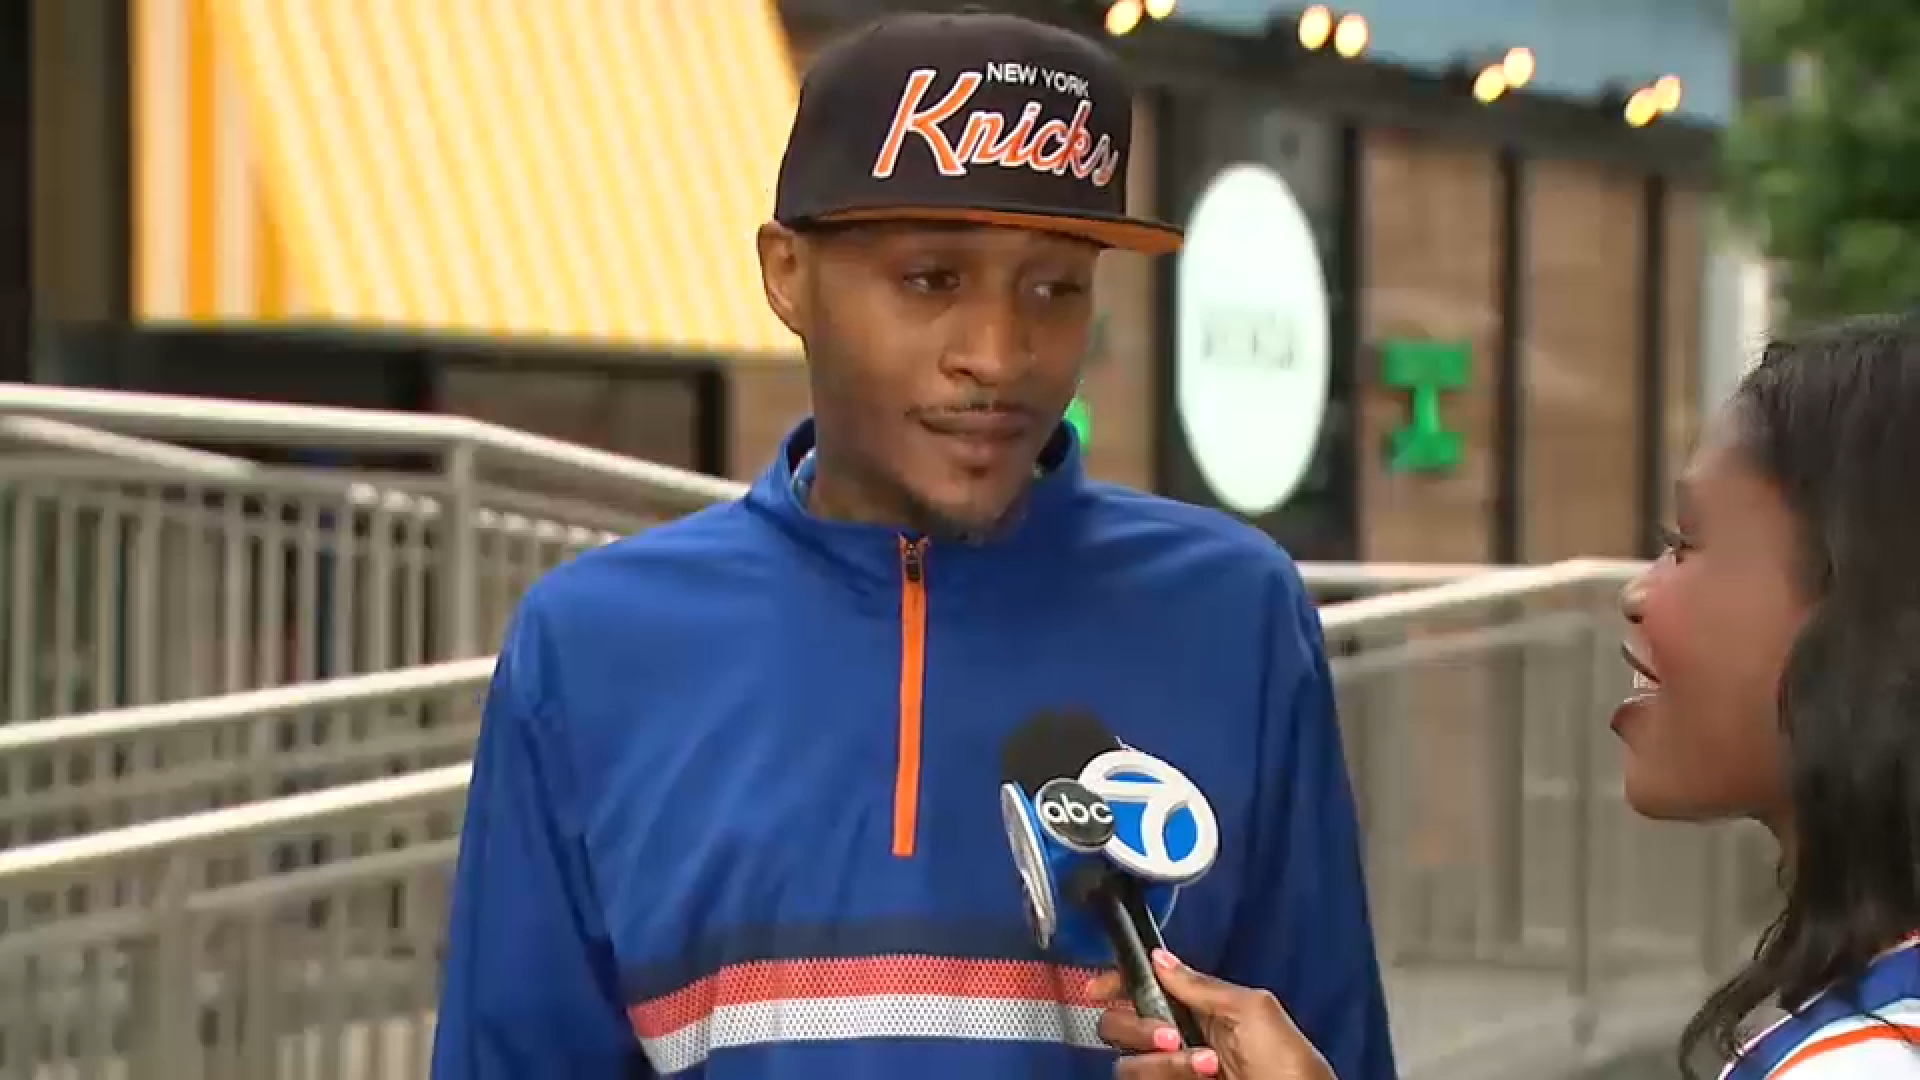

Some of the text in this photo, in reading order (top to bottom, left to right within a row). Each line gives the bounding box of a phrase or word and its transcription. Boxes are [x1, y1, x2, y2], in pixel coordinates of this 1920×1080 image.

[987, 61, 1089, 97] NEW YORK
[872, 69, 1119, 187] Knicks
[1043, 793, 1114, 824] abc
[1097, 774, 1199, 875] 7
